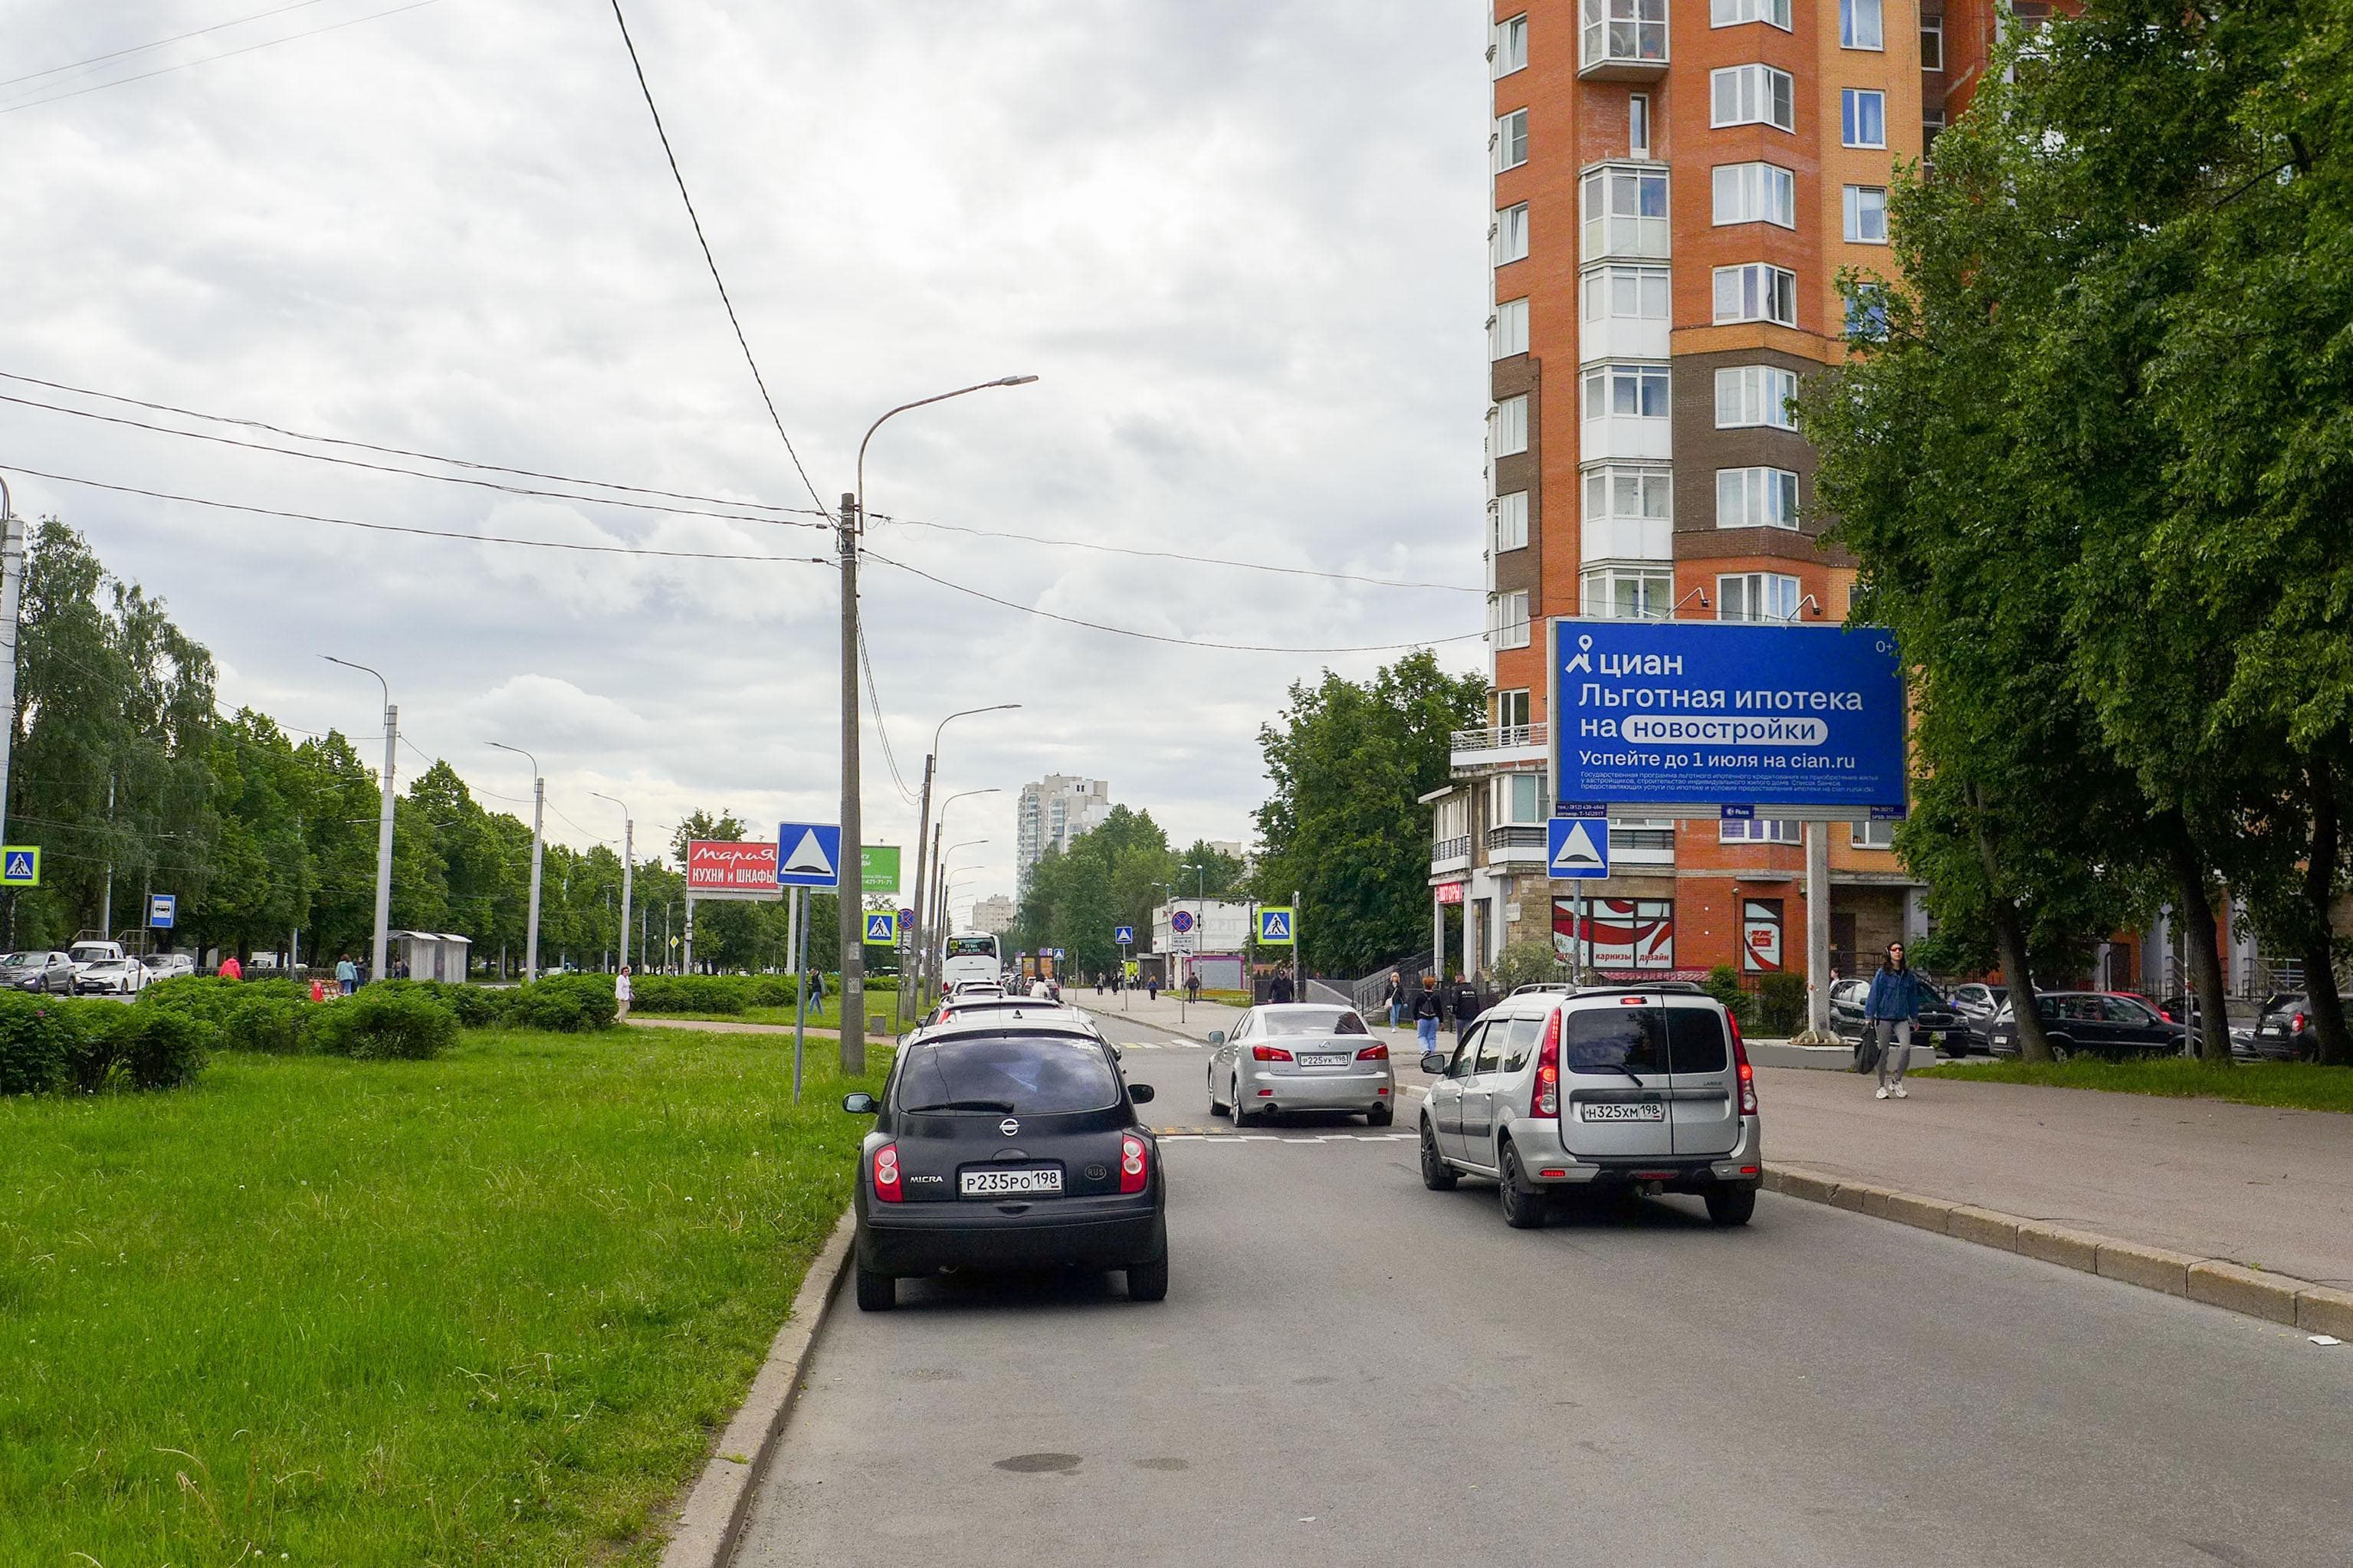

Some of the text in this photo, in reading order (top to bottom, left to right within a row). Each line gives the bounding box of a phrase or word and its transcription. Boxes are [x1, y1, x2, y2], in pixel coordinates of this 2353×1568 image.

[1600, 653, 1683, 677] циан
[1579, 683, 1863, 711] Льготная ипотека
[1580, 717, 1816, 744] на новостройки
[1579, 750, 1855, 769] Успейте до 1 июля на cian.ru
[693, 847, 776, 869] Мария
[692, 868, 775, 884] КУХНИ и ШКАФЫ
[1595, 953, 1632, 961] карнизы
[1639, 953, 1669, 962] дизайн
[1640, 1105, 1658, 1114] 198
[1033, 1172, 1058, 1185] 198
[1087, 1168, 1104, 1177] RUS
